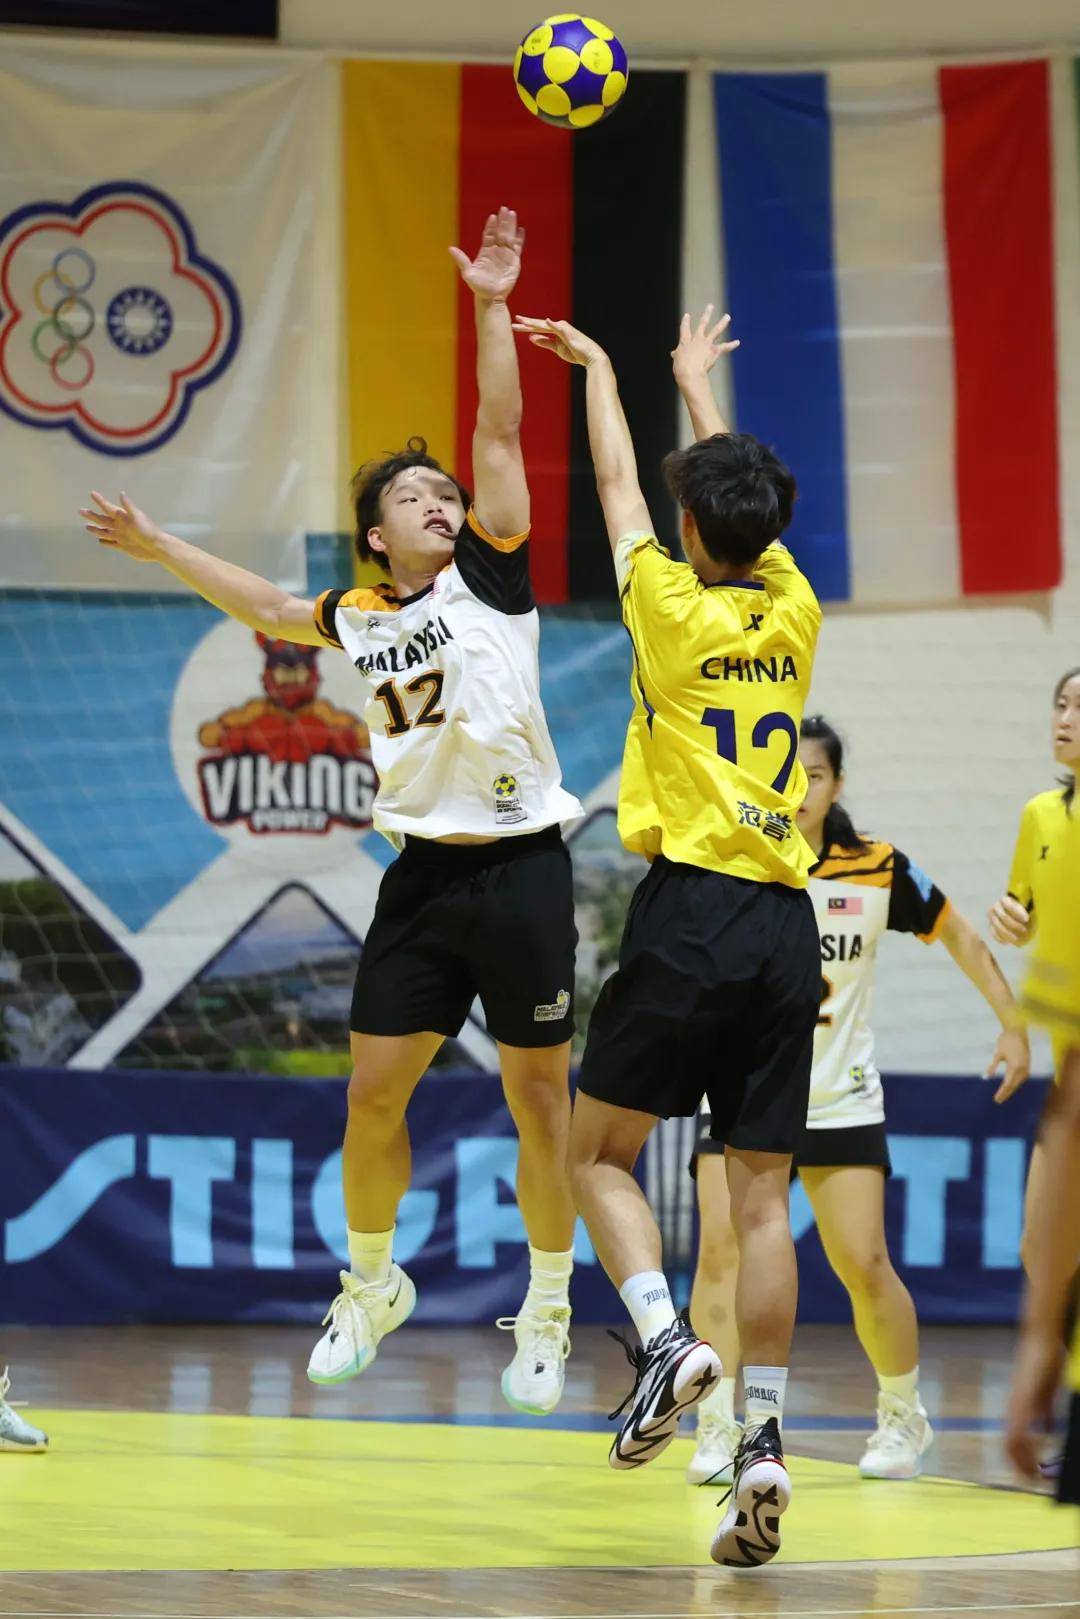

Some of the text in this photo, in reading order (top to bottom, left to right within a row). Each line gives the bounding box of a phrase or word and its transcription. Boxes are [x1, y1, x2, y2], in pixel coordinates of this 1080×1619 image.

[373, 668, 447, 738] 12
[700, 655, 798, 683] CHINA
[203, 753, 375, 820] VIKING
[700, 707, 798, 795] 12
[4, 1133, 598, 1269] STIGA
[788, 1136, 1026, 1269] TI
